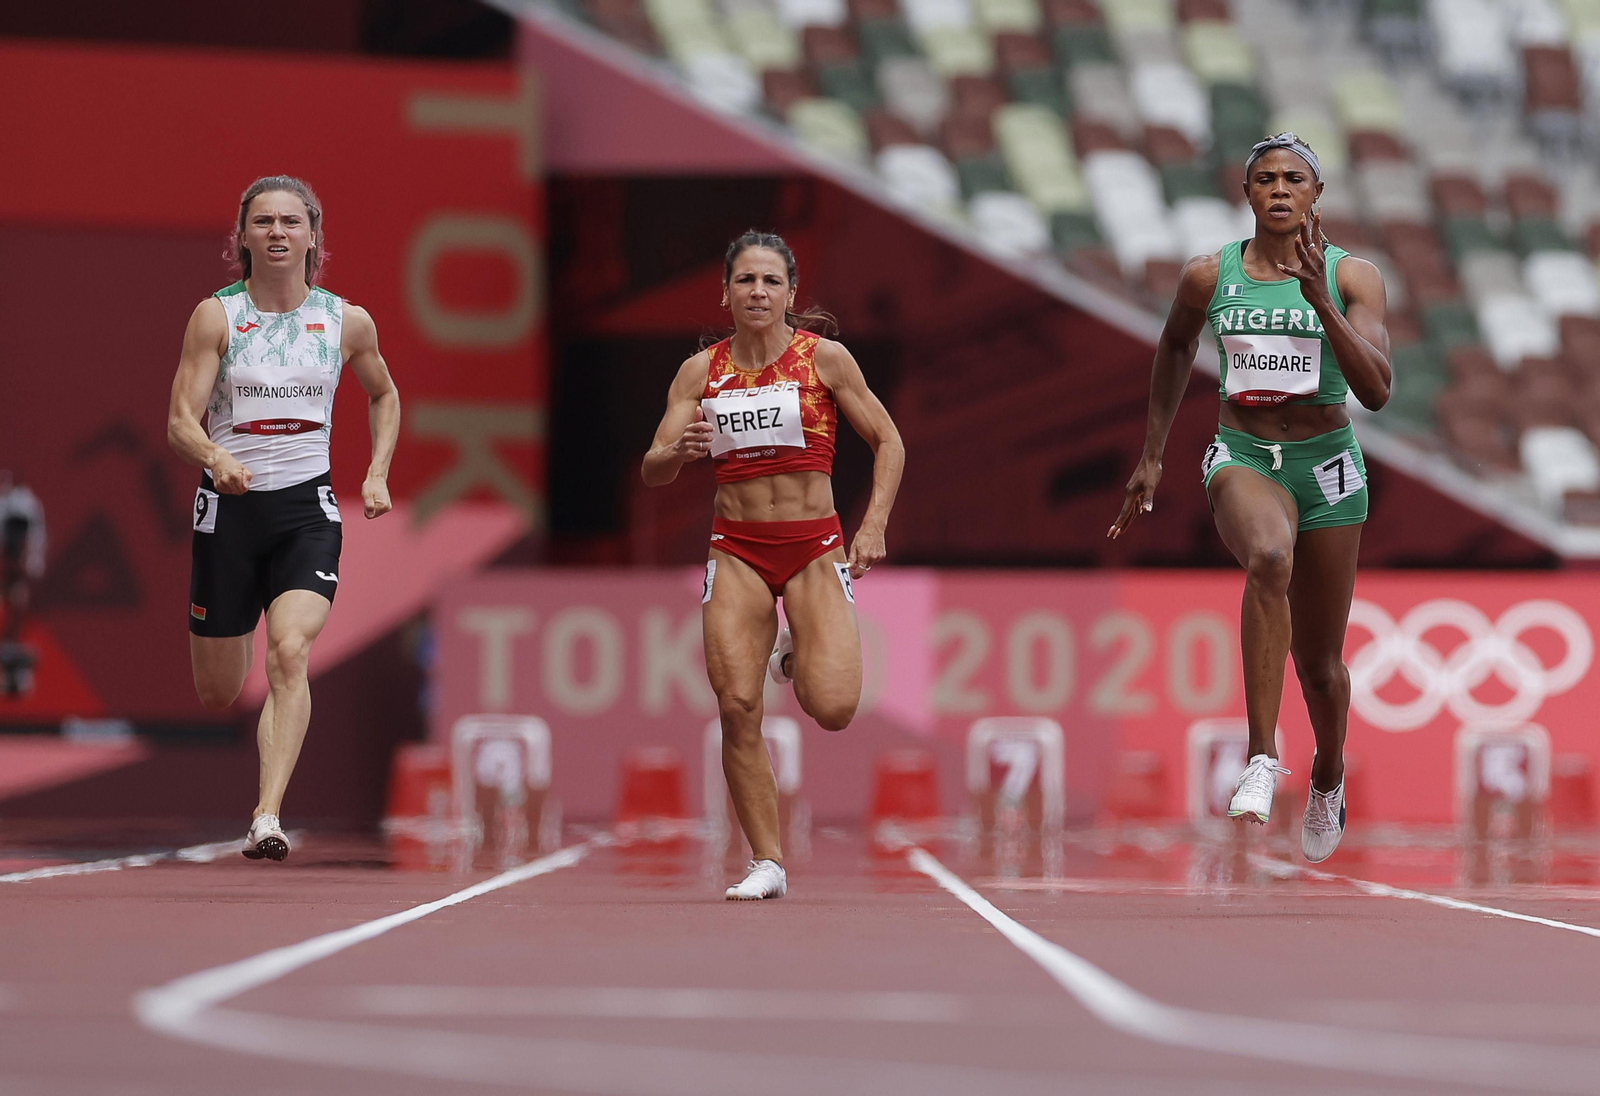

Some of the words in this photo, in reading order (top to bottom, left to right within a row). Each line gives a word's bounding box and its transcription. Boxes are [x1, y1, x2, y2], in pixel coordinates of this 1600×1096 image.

[1233, 353, 1312, 372] OKAGBARE
[236, 386, 323, 398] TSIMANOUSKAYA
[716, 406, 783, 434] PEREZ
[1322, 457, 1346, 496] 7
[195, 492, 209, 527] 9
[932, 609, 1236, 716] 2020
[989, 741, 1038, 808] 7
